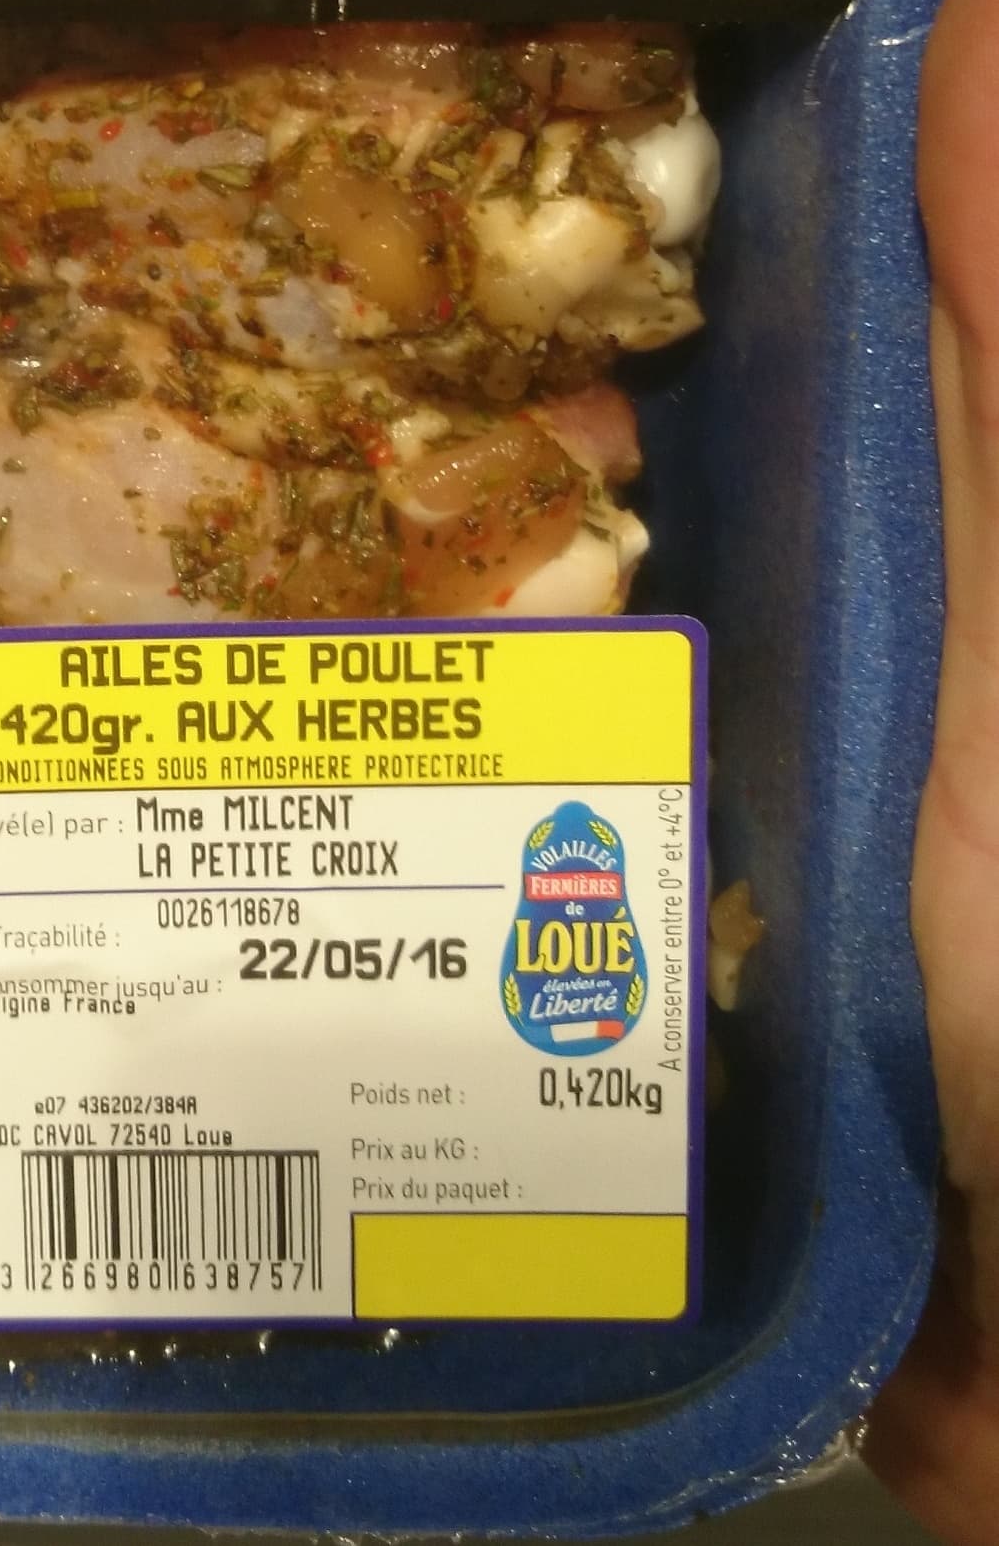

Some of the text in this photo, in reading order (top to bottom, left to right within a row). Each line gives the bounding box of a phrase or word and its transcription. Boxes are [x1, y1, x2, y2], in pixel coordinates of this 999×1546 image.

[60, 640, 494, 688] AILES DE POULET
[0, 697, 482, 755] 420gr. AUX HERBES
[157, 755, 208, 782] SOUS
[220, 752, 352, 781] ATMOSPHERE
[365, 751, 504, 779] PROTECTRICE
[65, 815, 108, 839] par
[135, 796, 204, 833] Mme
[224, 795, 354, 832] MILCENT
[136, 841, 399, 879] LA PETITE CROIX
[531, 840, 617, 872] VOLAILLES
[156, 898, 302, 930] 0026118678
[565, 901, 584, 916] de
[514, 906, 635, 975] LOUÉ
[238, 937, 468, 983] 22/05/16
[663, 895, 682, 1052] conserver entre
[64, 992, 136, 1015] France
[115, 975, 208, 1002] jusqu'au
[529, 989, 619, 1019] Liberté
[79, 1096, 197, 1115] 436202/384A
[349, 1082, 453, 1106] Poids net
[539, 1067, 664, 1117] 0,420kg
[34, 1124, 97, 1146] CAVOL
[110, 1124, 172, 1146] 72540
[184, 1124, 232, 1146] Loue
[350, 1138, 466, 1162] Prix au KG
[350, 1177, 509, 1205] Prix du paquet
